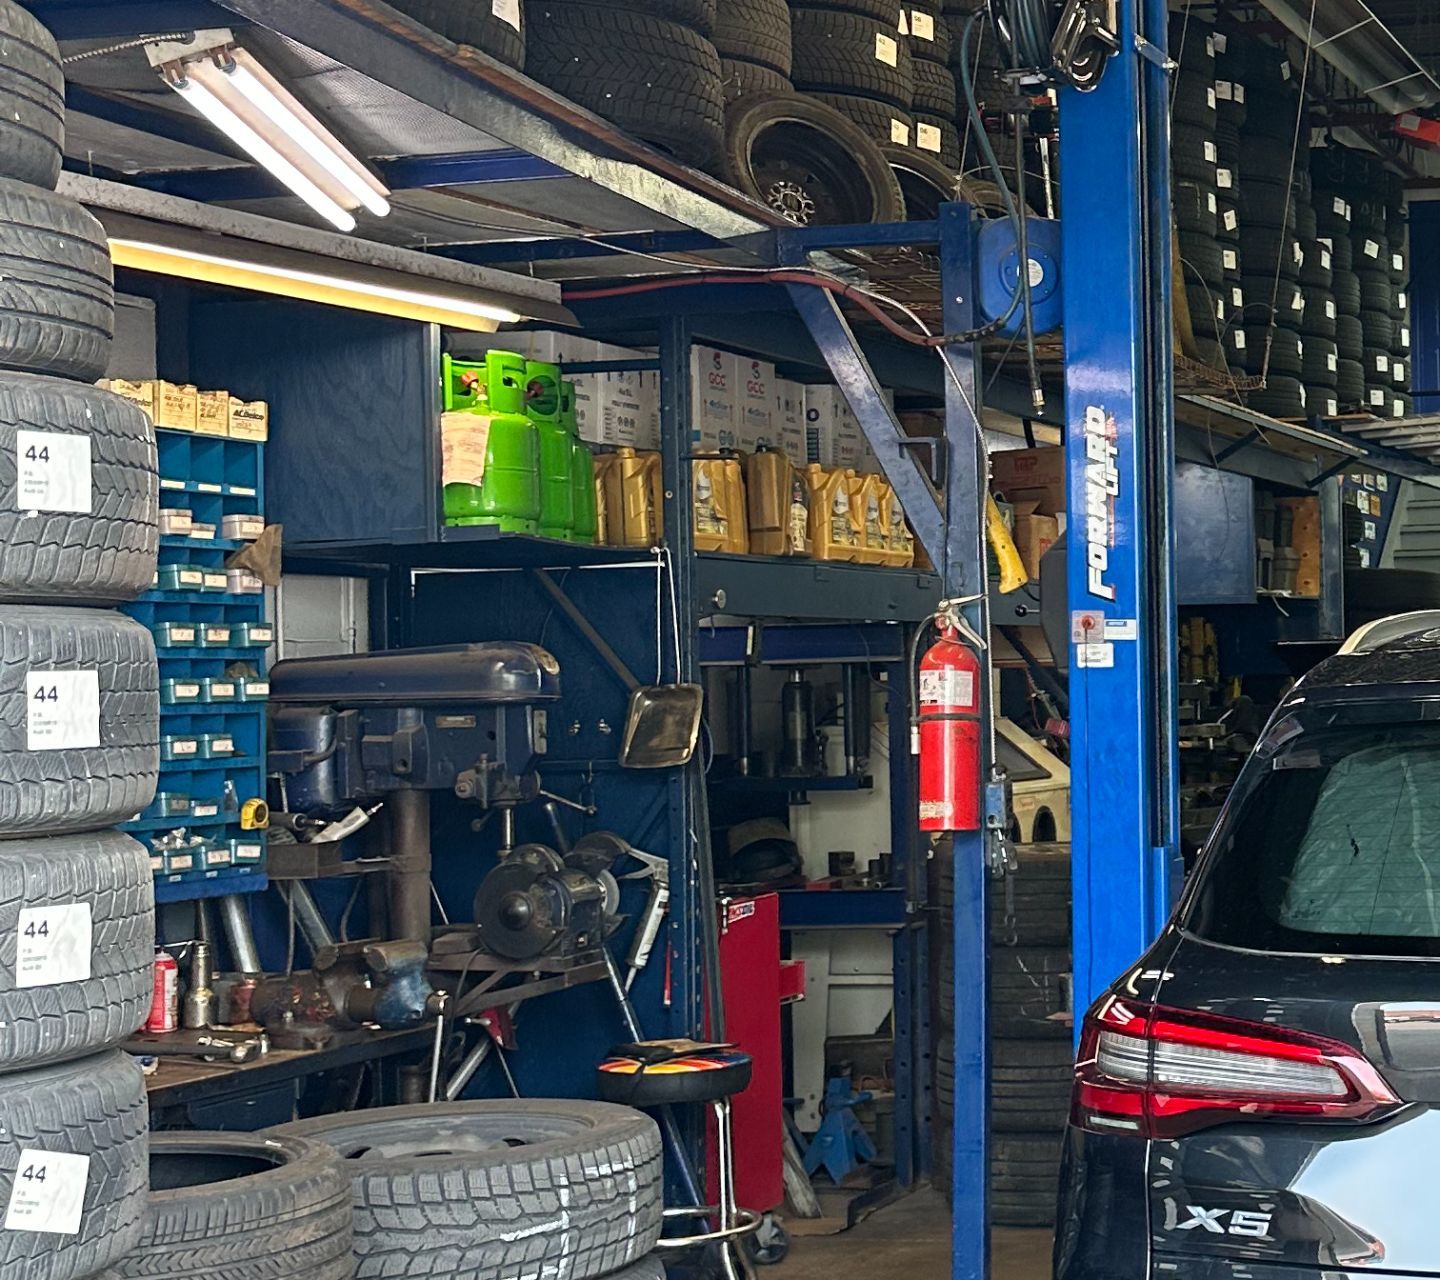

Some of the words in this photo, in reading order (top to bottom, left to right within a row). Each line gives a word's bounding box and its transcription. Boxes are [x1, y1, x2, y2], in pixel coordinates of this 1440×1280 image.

[25, 444, 50, 463] 44
[1085, 405, 1115, 600] FORWARD
[33, 685, 59, 703] 44
[24, 919, 49, 939] 44
[22, 1164, 47, 1184] 44
[1175, 1204, 1273, 1237] X5
